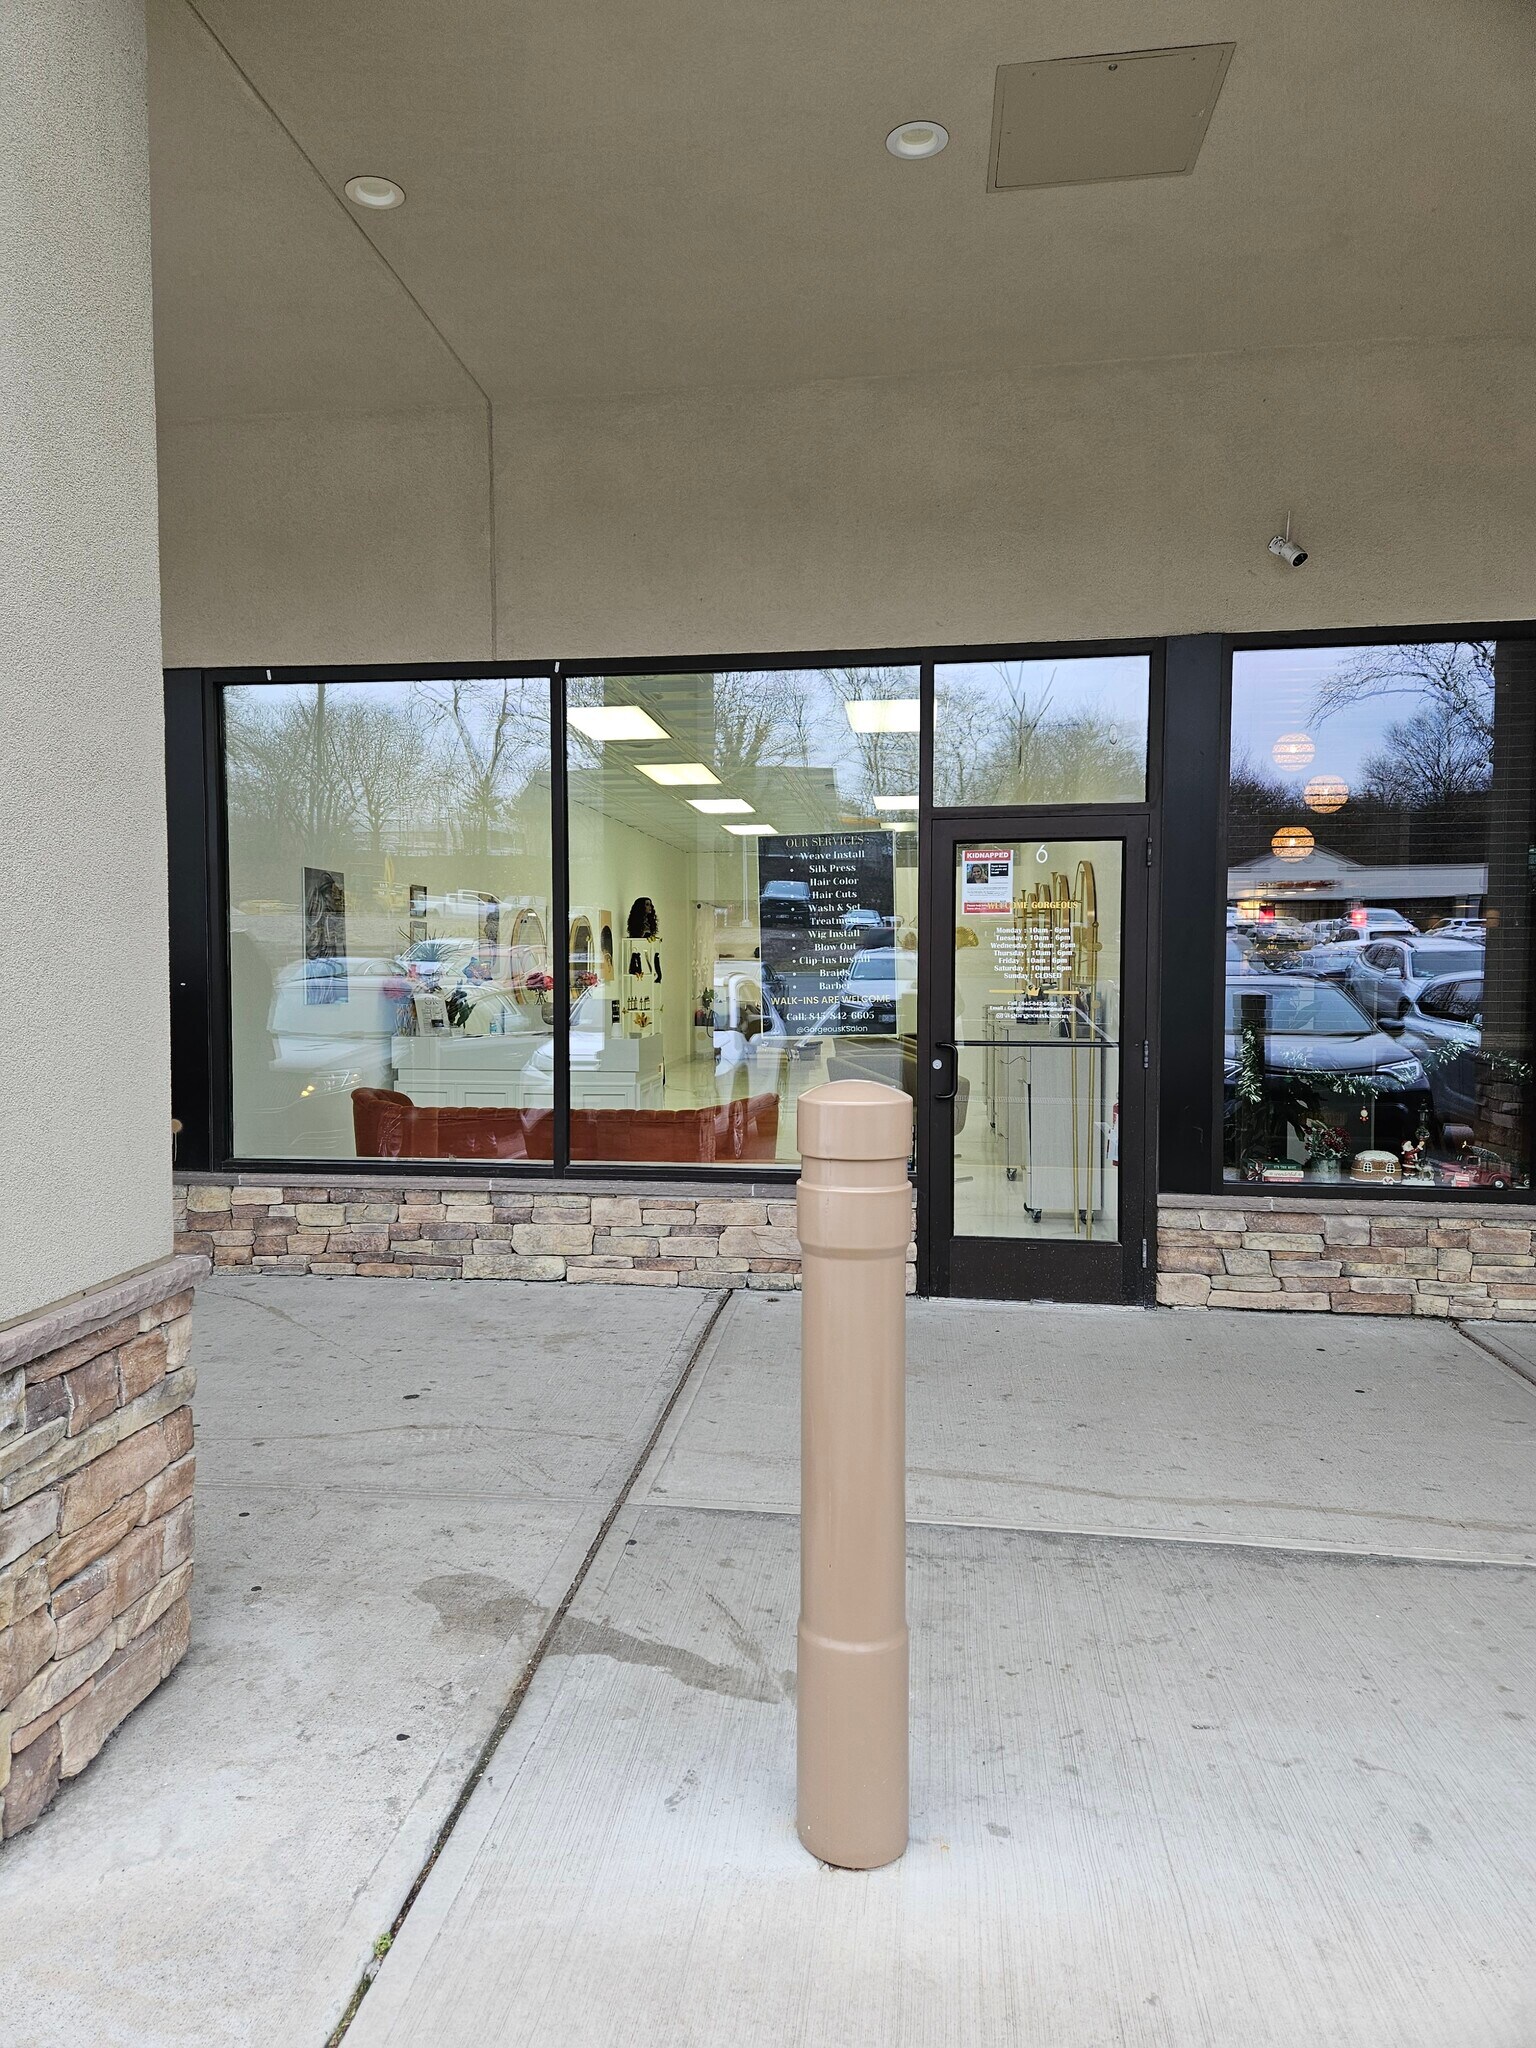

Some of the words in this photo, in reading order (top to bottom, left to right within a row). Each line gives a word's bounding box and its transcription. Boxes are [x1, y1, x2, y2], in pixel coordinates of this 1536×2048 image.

[786, 838, 808, 848] OUR
[812, 836, 864, 847] SERVICES
[834, 850, 865, 858] Install
[1036, 844, 1048, 864] 6
[809, 865, 827, 873] Silk
[808, 904, 834, 912] Wash
[810, 917, 860, 925] Treatment
[808, 930, 827, 940] Wig
[829, 930, 860, 938] Install
[814, 943, 838, 952] Blow
[840, 942, 856, 950] Out
[799, 957, 836, 966] Clip-Ins
[771, 996, 819, 1005] WALK-INS
[821, 996, 839, 1004] ARE
[842, 995, 890, 1003] WELCOME
[787, 1013, 807, 1021] Call:
[809, 1012, 875, 1021] 845842-6605
